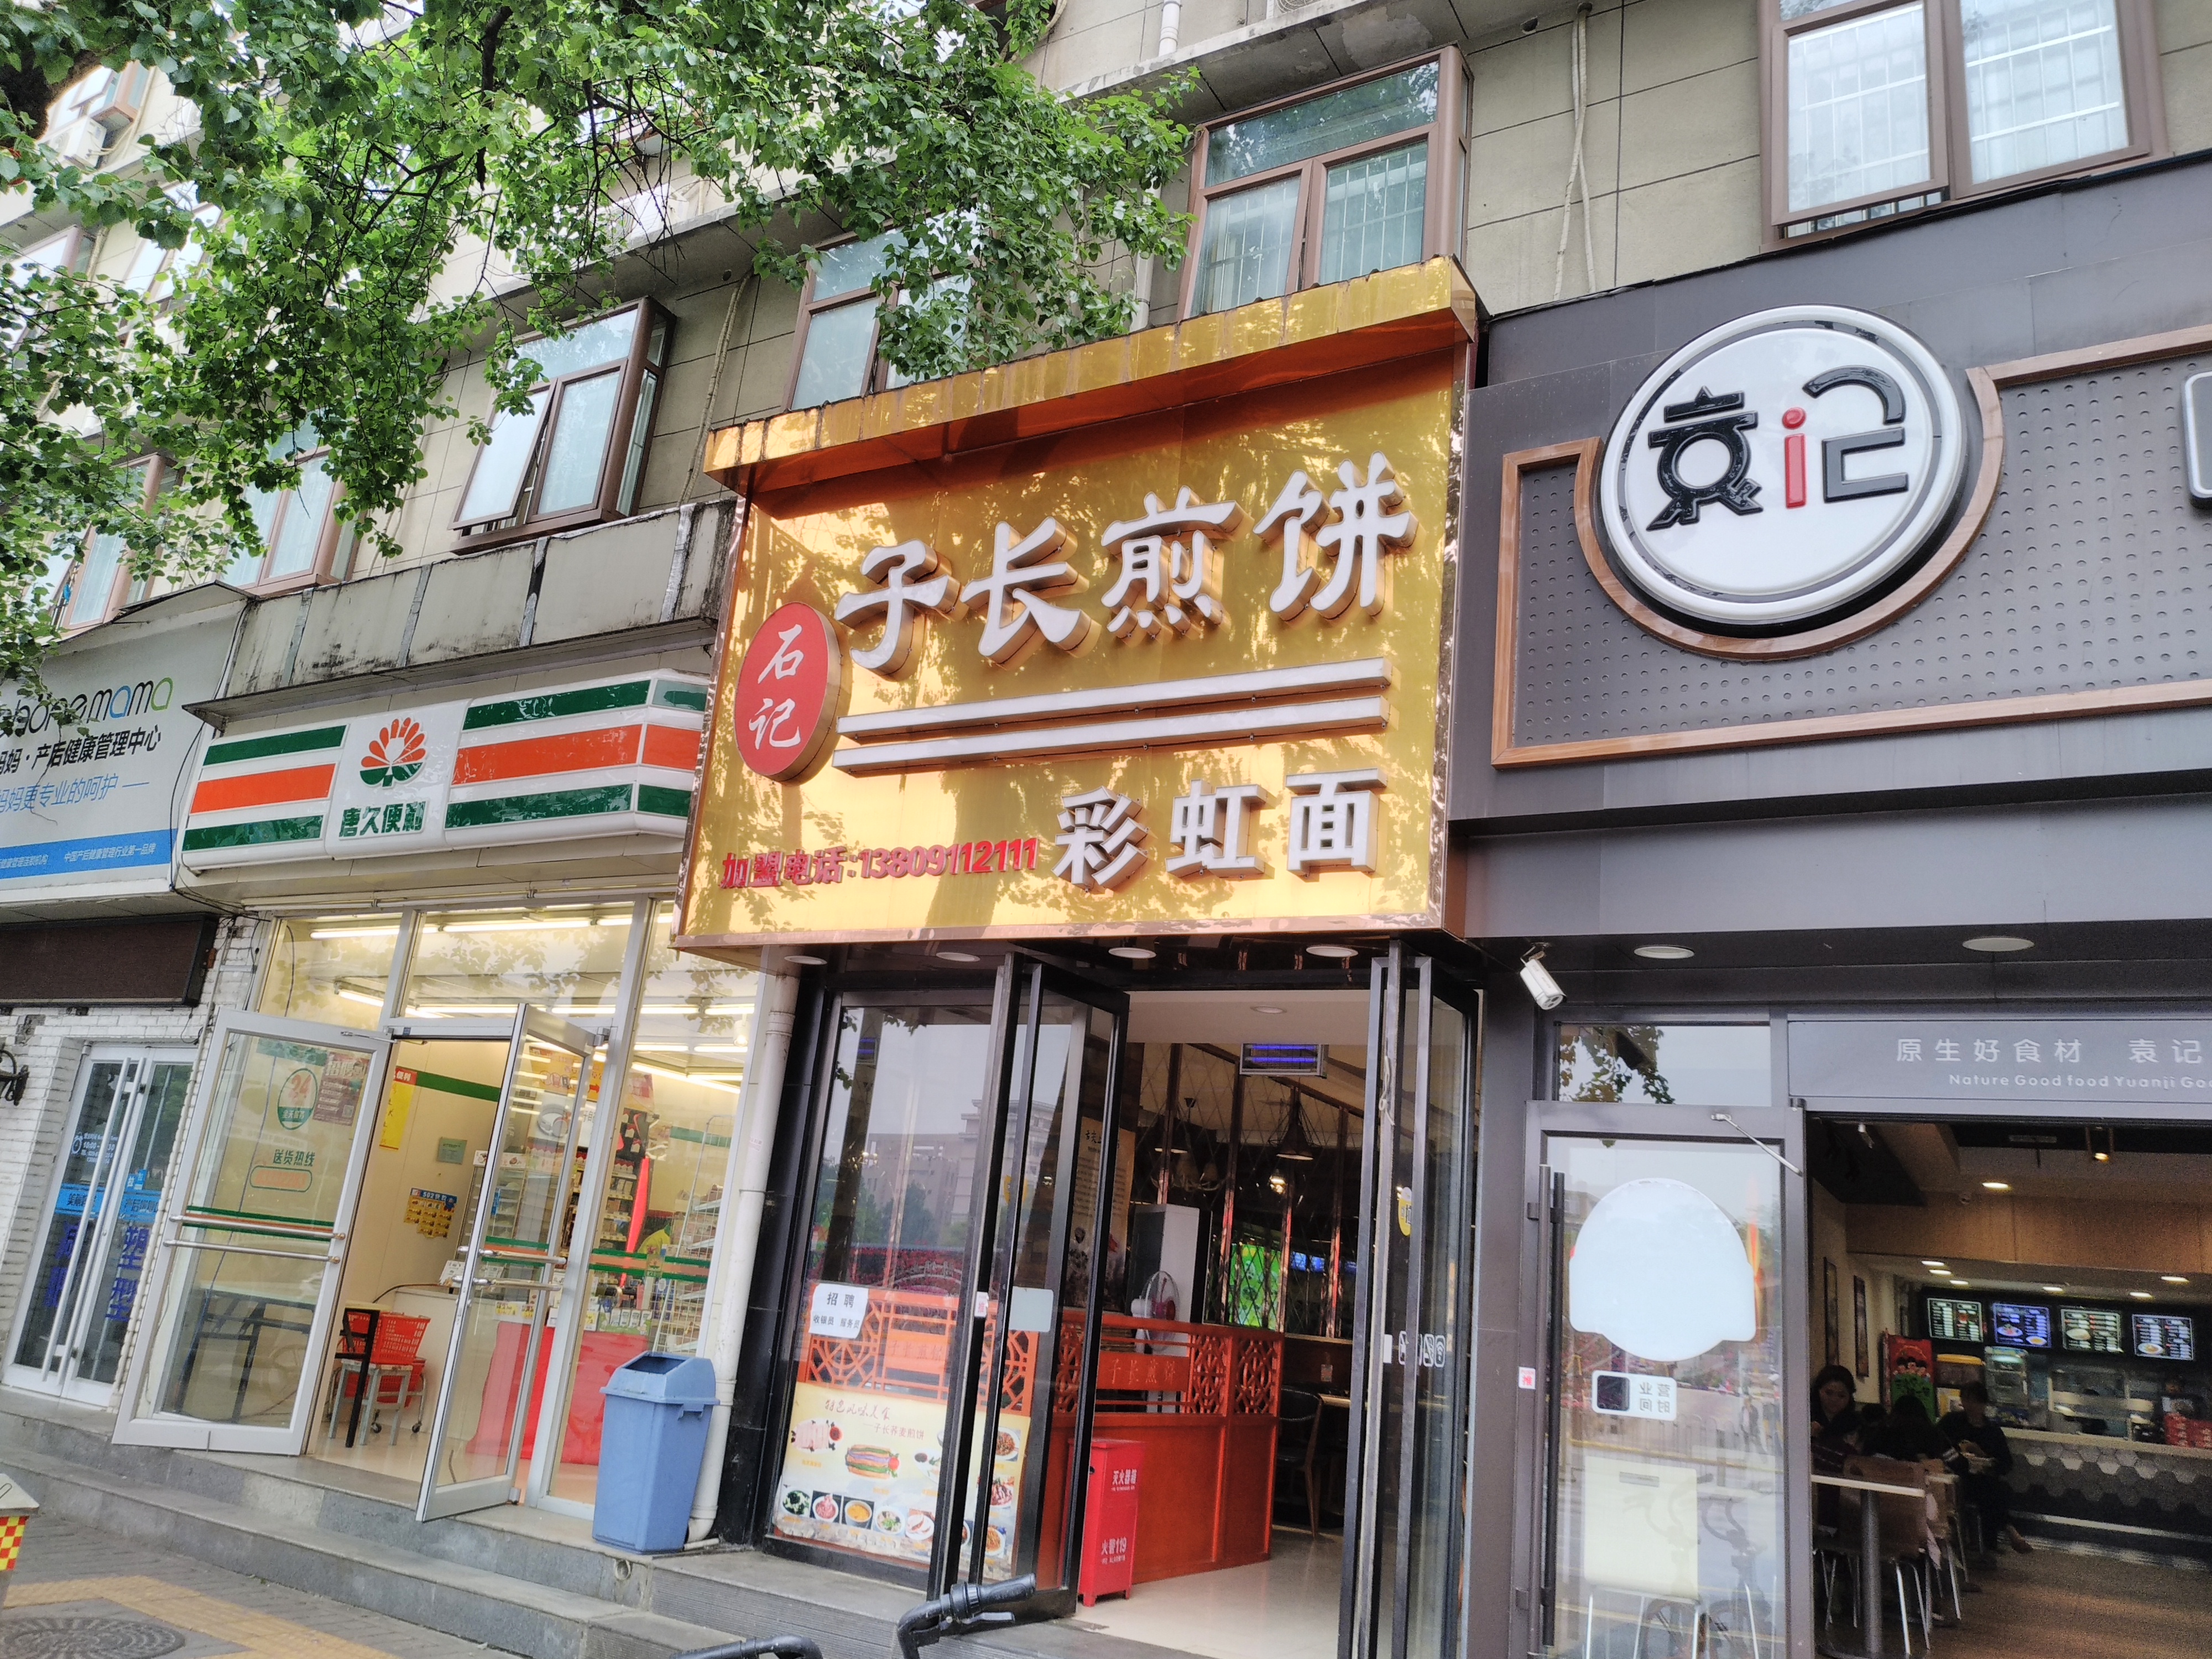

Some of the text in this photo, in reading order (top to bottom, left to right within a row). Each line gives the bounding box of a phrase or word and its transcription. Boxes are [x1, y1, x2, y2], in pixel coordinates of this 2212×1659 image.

[834, 450, 1412, 671] 子长煎饼
[748, 623, 804, 750] 石记
[338, 801, 426, 837] 唐久便利
[1052, 768, 1383, 887] 彩虹面
[719, 837, 1039, 889] 加盟电话:13809112111
[1896, 1037, 2203, 1065] 原生好食材 袁记
[1949, 1074, 2008, 1086] Nature
[2015, 1074, 2062, 1087] Good
[2067, 1074, 2109, 1088] food
[2114, 1076, 2176, 1090] Yuanji
[273, 1149, 316, 1167] 送货热线
[827, 1291, 855, 1308] 招聘
[813, 1314, 860, 1329] 收银员 服务员
